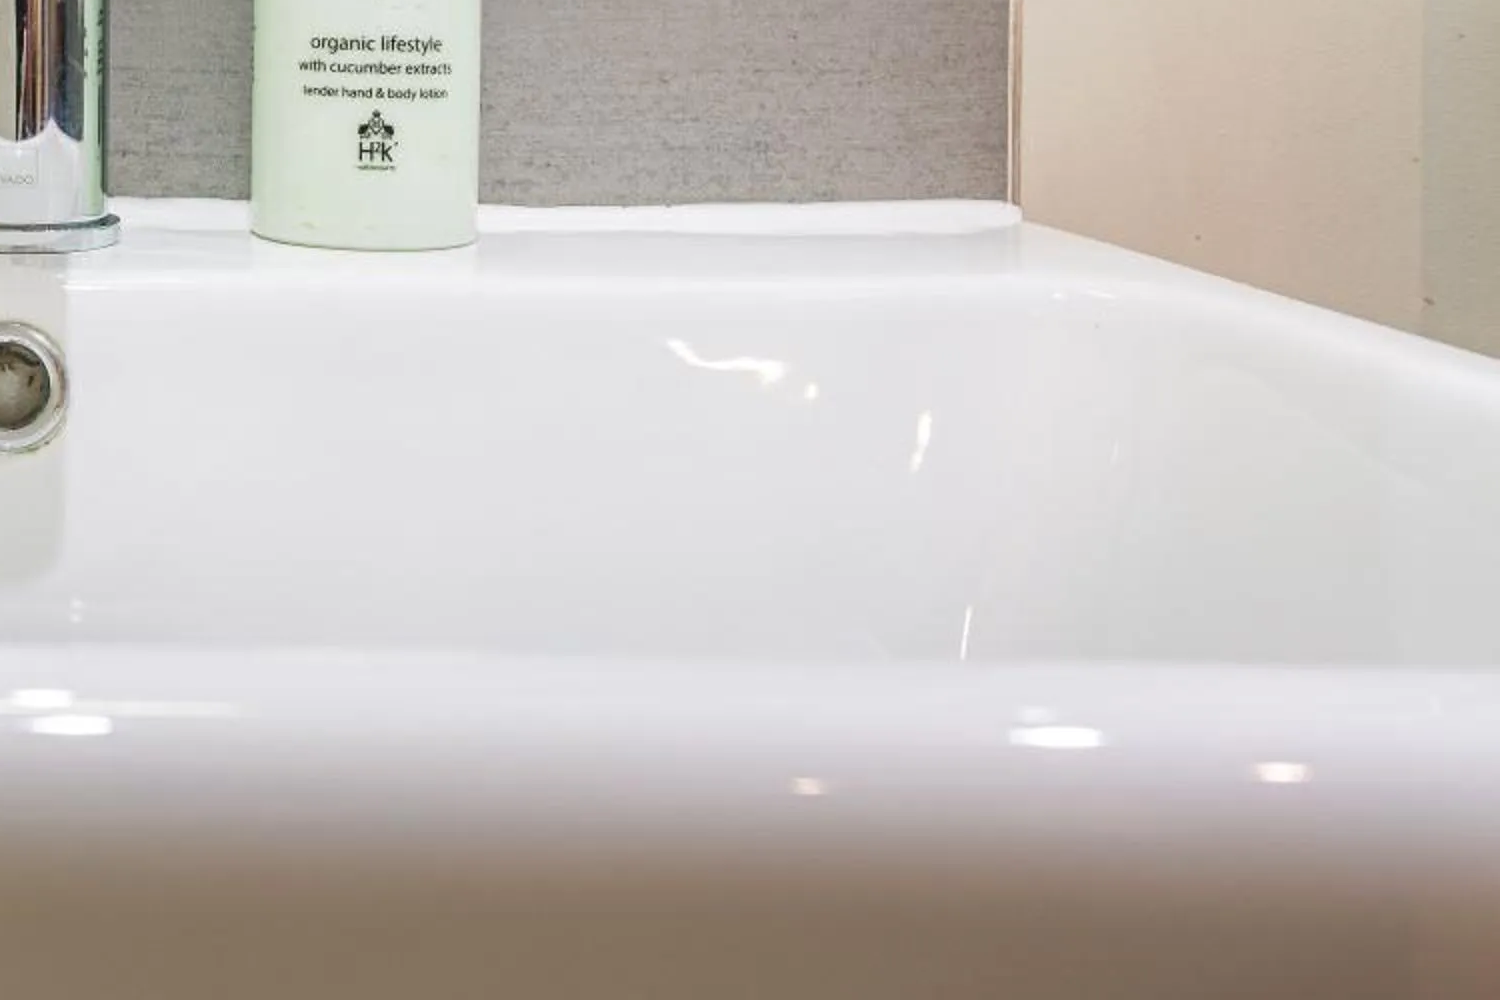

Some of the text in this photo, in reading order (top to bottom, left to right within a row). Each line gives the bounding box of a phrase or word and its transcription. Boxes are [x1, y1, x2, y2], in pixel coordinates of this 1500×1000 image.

[310, 35, 443, 56] organic lifestyle
[299, 58, 453, 75] with cucumber extracts
[341, 85, 373, 99] hand
[375, 87, 385, 99] &
[387, 87, 417, 102] body
[419, 88, 449, 99] lotion
